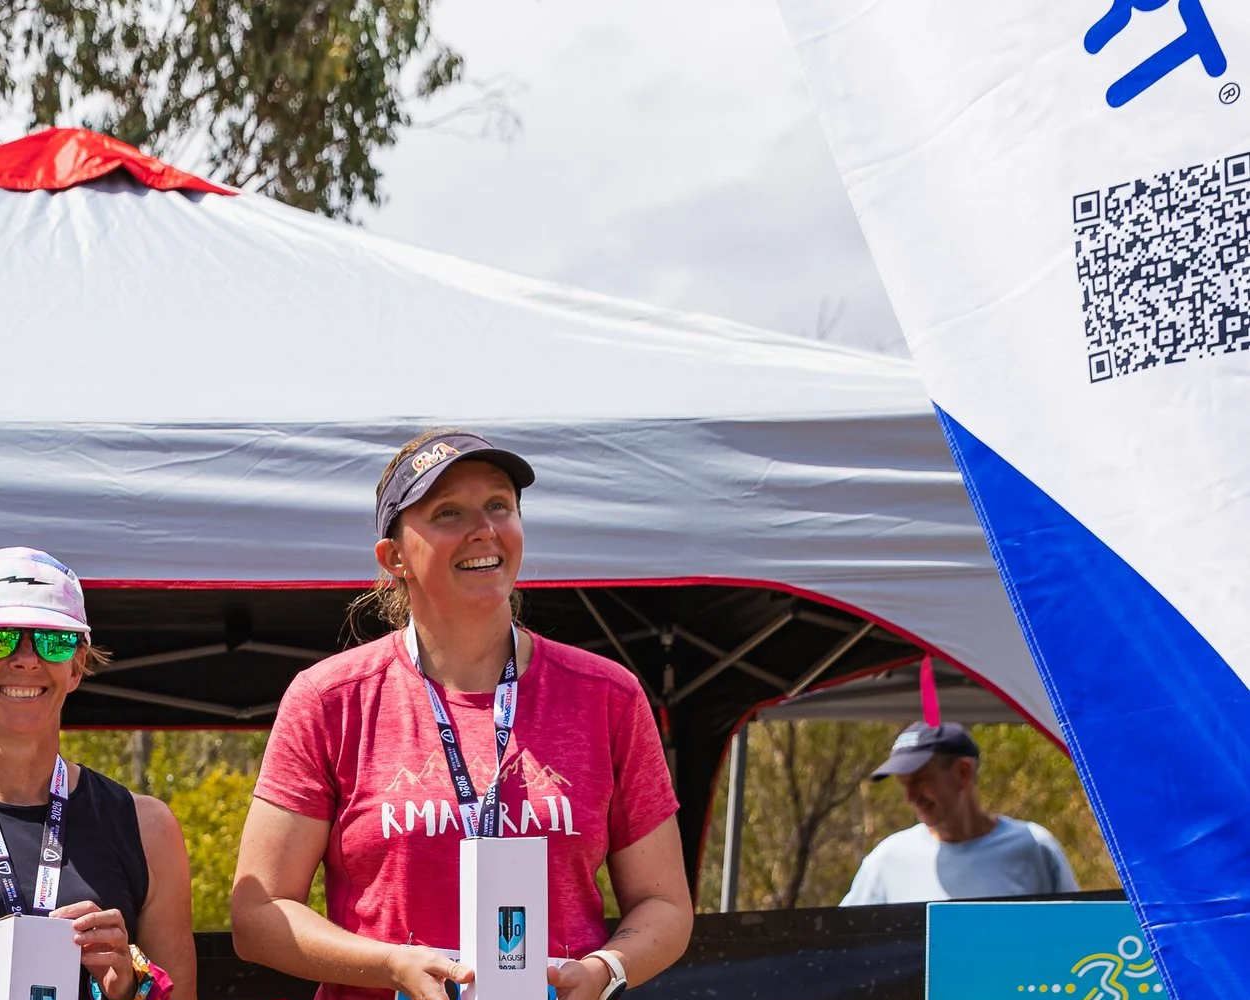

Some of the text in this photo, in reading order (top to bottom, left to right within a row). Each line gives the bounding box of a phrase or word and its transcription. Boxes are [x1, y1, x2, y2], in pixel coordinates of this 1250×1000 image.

[455, 775, 471, 798] 2026
[50, 801, 63, 822] 2026
[381, 794, 582, 839] RMA RAIL
[39, 866, 50, 902] INTERSPORT
